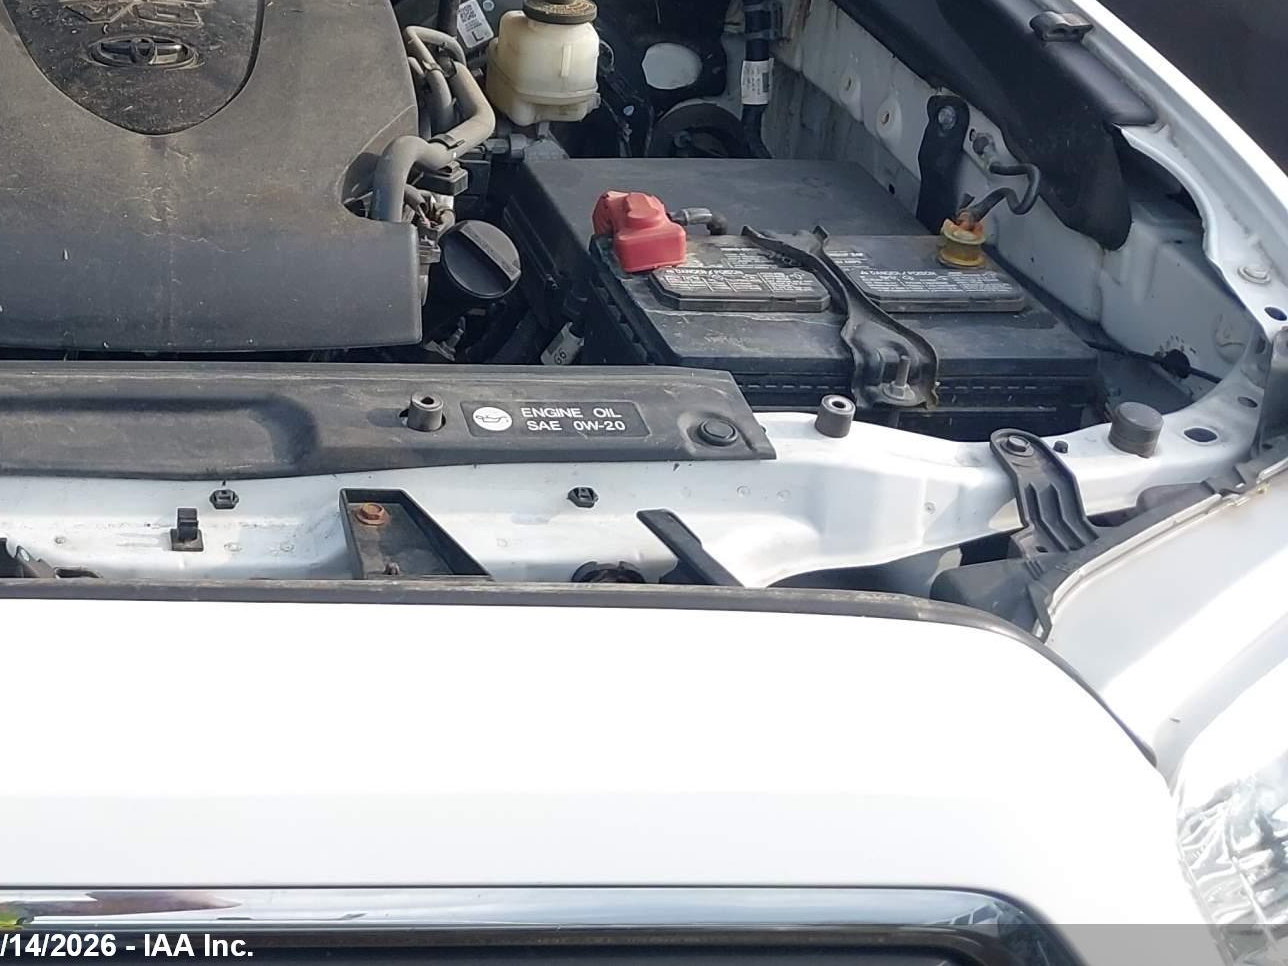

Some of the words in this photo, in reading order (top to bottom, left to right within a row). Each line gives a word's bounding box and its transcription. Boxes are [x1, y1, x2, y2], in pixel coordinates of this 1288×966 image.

[471, 31, 485, 42] L
[520, 407, 583, 419] ENGINE
[593, 407, 622, 419] OIL
[527, 420, 562, 431] SAE
[573, 420, 626, 432] 0W-20
